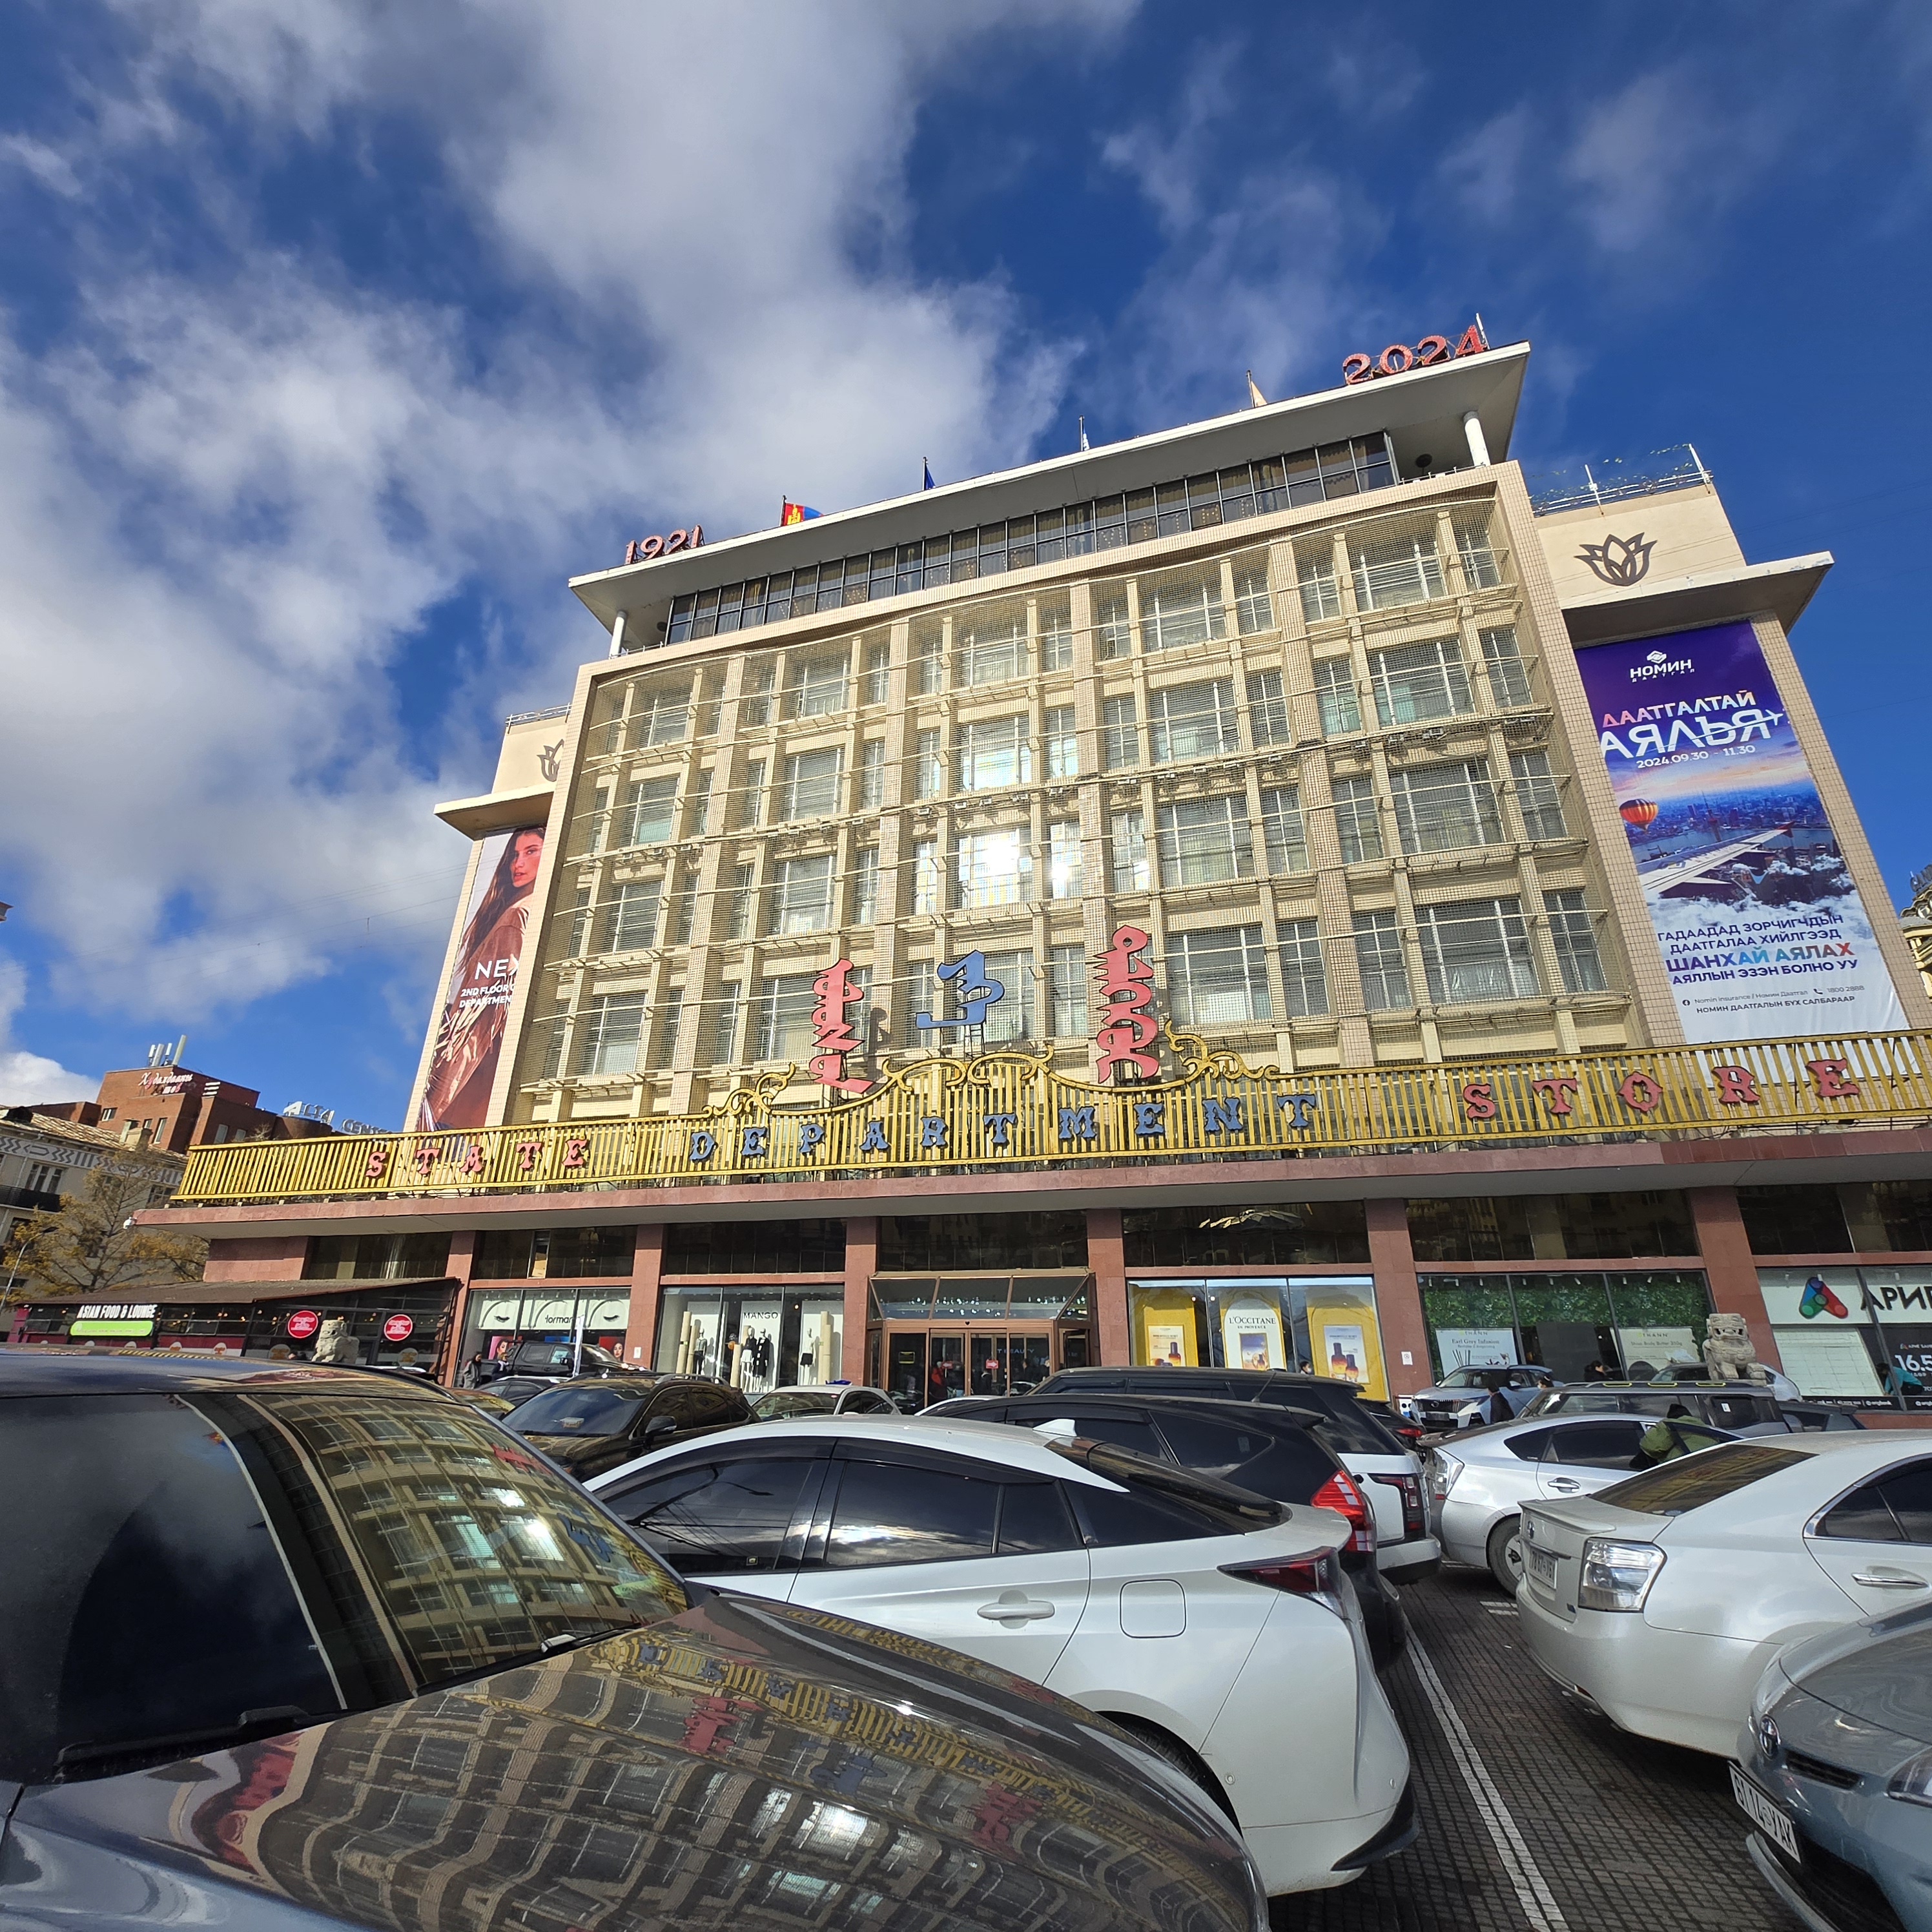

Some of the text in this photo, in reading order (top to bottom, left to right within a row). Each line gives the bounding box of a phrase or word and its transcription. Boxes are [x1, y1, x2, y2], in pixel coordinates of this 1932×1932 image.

[1342, 324, 1487, 385] 2024
[624, 524, 701, 565] 1921
[1630, 659, 1692, 679] НОМИН
[1632, 668, 1695, 683] ДААТГАЛ
[1602, 690, 1756, 728] ДААТГАЛТАЙ
[1636, 751, 1709, 768] 2024.09.30
[1723, 745, 1756, 757] 11.30
[1658, 914, 1844, 941] ГАДААДАД ЗОРЧИГЧДЫН
[1670, 929, 1842, 956] ДААТГАЛАА ХИЙЛГЭЭД
[1665, 942, 1855, 972] ШАНХАЙ АЯЛАХ
[1672, 969, 1735, 985] АЯЛЛЫН
[1738, 967, 1779, 978] ЭЗЭН
[1782, 962, 1834, 974] БОЛНО
[460, 987, 479, 997] 2ND
[480, 984, 508, 995] FLOOR
[1696, 1005, 1729, 1013] НОМИН
[1731, 1001, 1783, 1012] ДААТГАЛЫН
[1802, 996, 1855, 1005] САЛБАРААР
[365, 1057, 1861, 1178] STATE DEPARTMENT STORE
[77, 1305, 101, 1319] ASIAN
[99, 1305, 121, 1319] FOOD
[127, 1304, 158, 1319] LOUNGE
[743, 1311, 779, 1320] MANGO
[1229, 1316, 1277, 1324] L'OCCITANE
